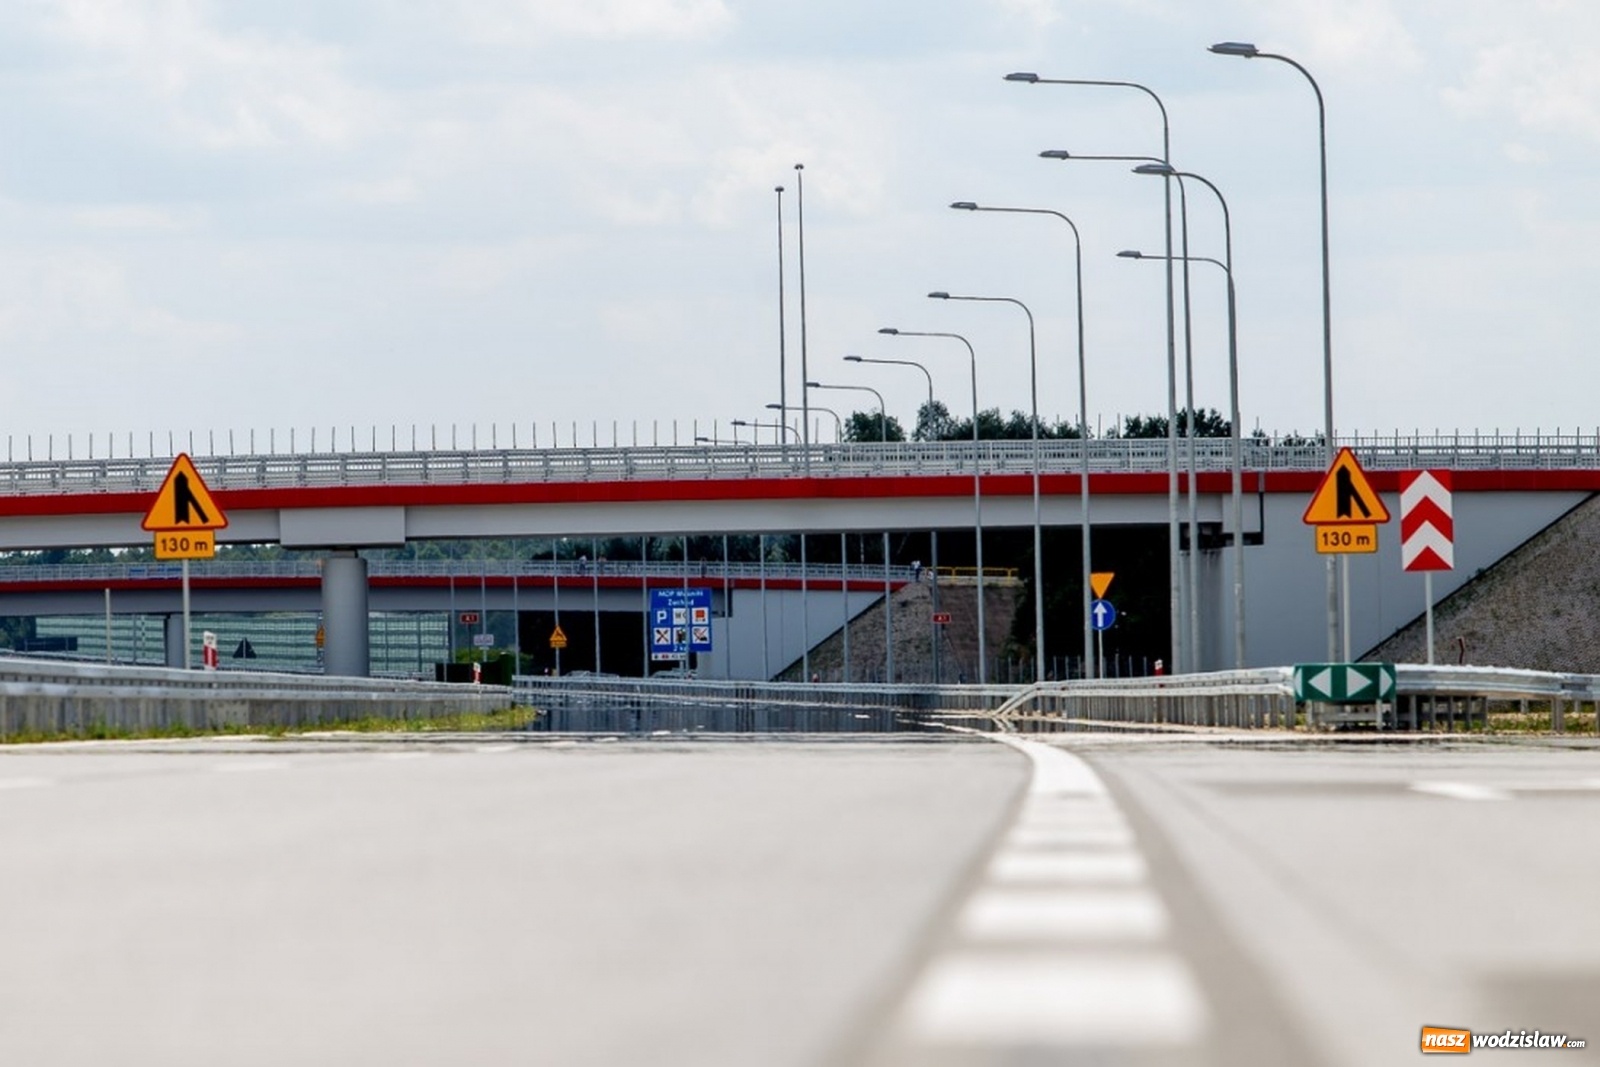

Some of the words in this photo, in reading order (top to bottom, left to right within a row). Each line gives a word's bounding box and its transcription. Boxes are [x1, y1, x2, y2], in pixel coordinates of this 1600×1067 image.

[161, 538, 190, 552] 130
[194, 541, 209, 551] m
[1322, 532, 1352, 546] 130
[1356, 535, 1370, 546] m
[657, 610, 667, 624] P
